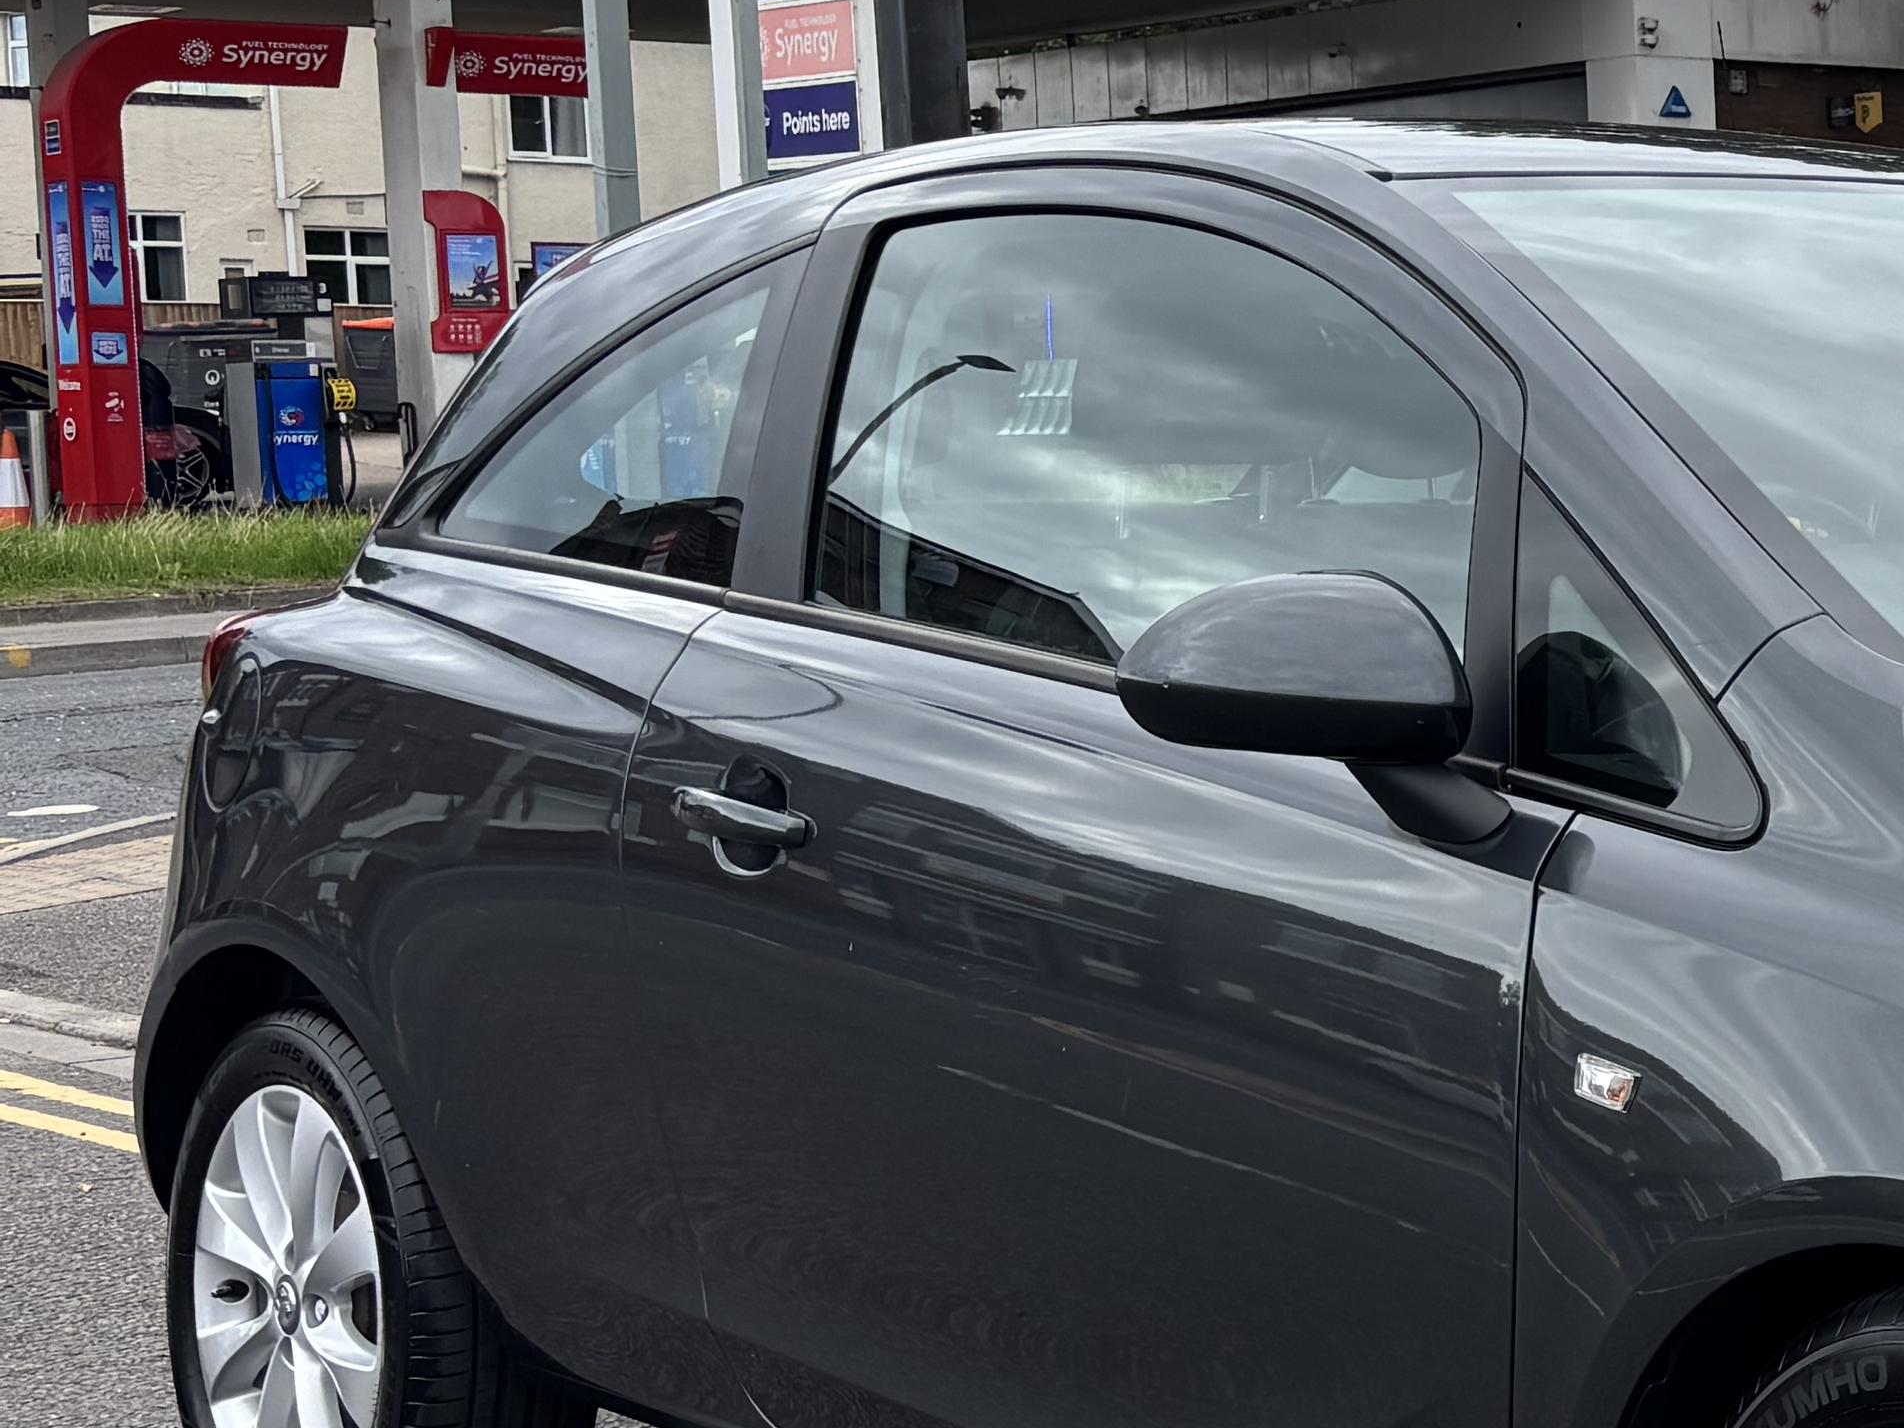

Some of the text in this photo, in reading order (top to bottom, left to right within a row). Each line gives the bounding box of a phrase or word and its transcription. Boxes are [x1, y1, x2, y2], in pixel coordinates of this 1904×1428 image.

[222, 44, 328, 71] Synergy
[242, 40, 329, 50] FUEL TECHNOLOGY
[775, 28, 838, 66] Synergy
[493, 56, 588, 83] Synergy
[782, 108, 851, 135] Points here
